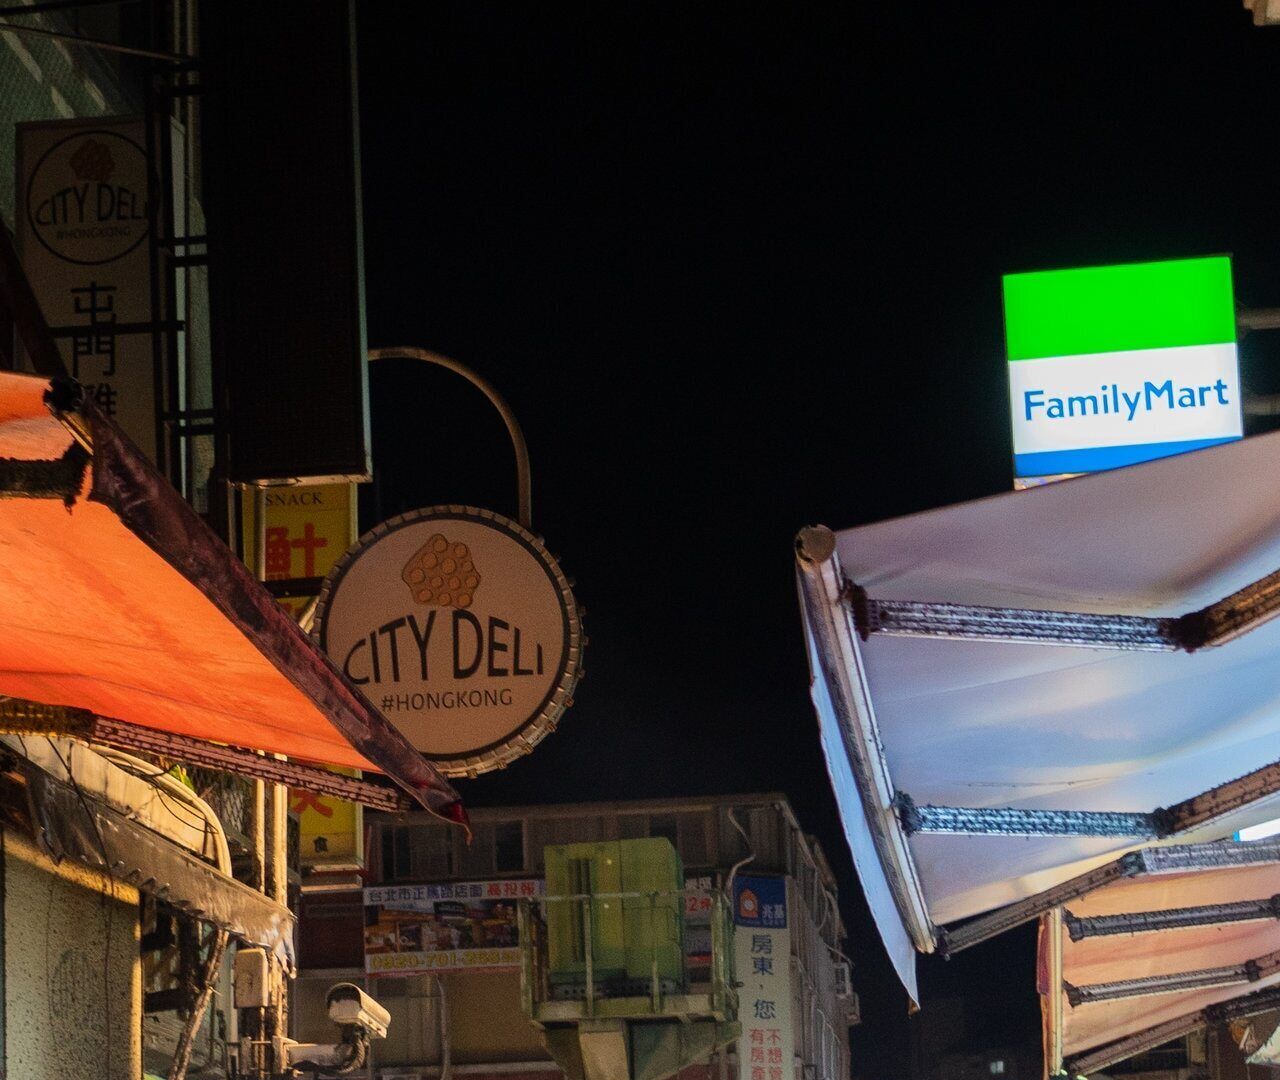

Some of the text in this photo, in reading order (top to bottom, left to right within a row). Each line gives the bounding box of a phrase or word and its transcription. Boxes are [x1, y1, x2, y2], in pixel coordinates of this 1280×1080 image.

[36, 184, 87, 226] CITY
[1023, 378, 1230, 421] FamilyMart
[264, 491, 323, 506] SNACK
[344, 608, 545, 684] CITY DELI
[381, 688, 513, 713] #HONGKONG
